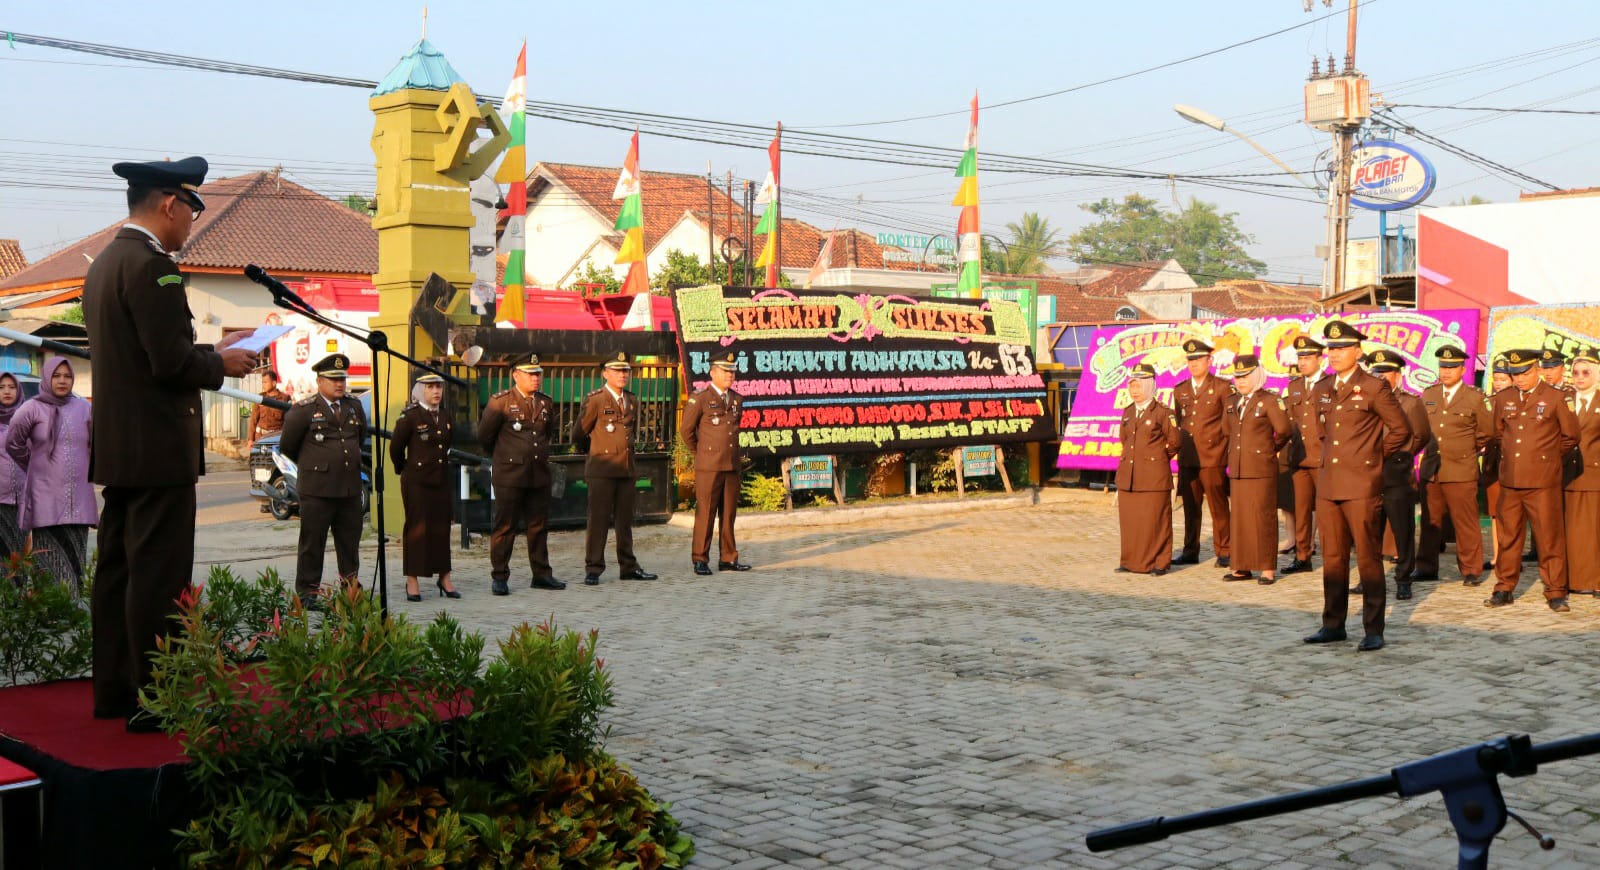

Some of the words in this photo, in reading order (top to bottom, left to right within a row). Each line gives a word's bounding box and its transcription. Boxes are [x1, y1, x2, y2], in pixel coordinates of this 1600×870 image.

[1354, 156, 1409, 184] PLANET
[1384, 174, 1404, 186] BAN
[727, 304, 836, 331] SELAMAT
[892, 308, 987, 335] SUKSES
[1119, 332, 1192, 358] SELAMA
[1353, 324, 1423, 353] ARI
[753, 350, 847, 372] BHAKTI
[851, 350, 968, 373] ADHYAKSA
[738, 429, 793, 453] OLRES
[970, 418, 1035, 436] STAFF
